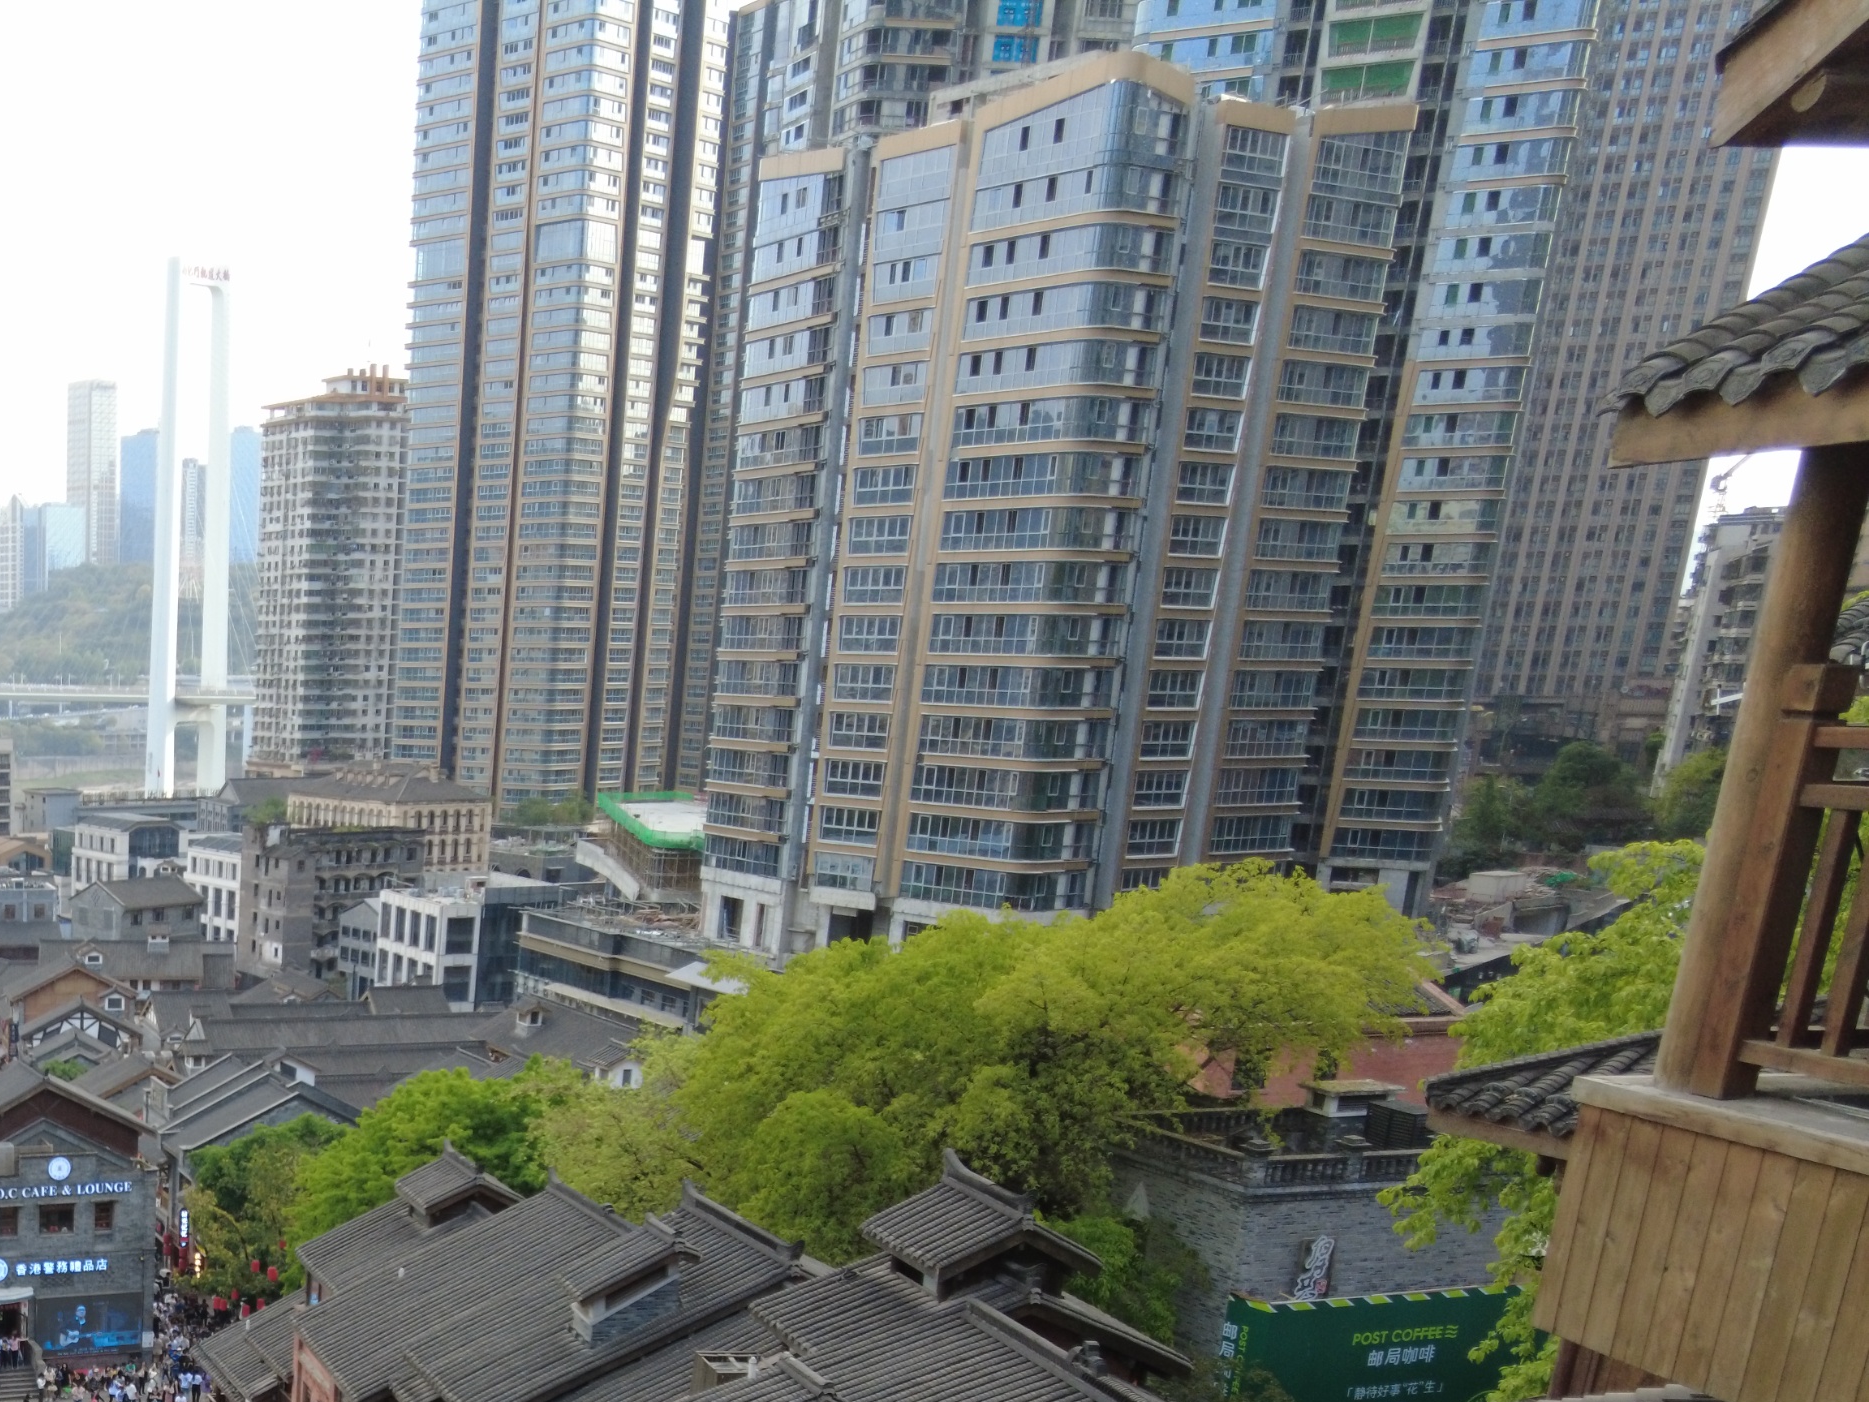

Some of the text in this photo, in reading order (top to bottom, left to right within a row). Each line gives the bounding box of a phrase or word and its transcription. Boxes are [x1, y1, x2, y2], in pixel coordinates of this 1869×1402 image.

[21, 1185, 58, 1199] CAFE
[62, 1185, 72, 1196] &
[77, 1181, 133, 1195] LOUNGE
[1352, 1326, 1444, 1346] POST COFFEE
[1367, 1344, 1437, 1367] 邮局咖啡
